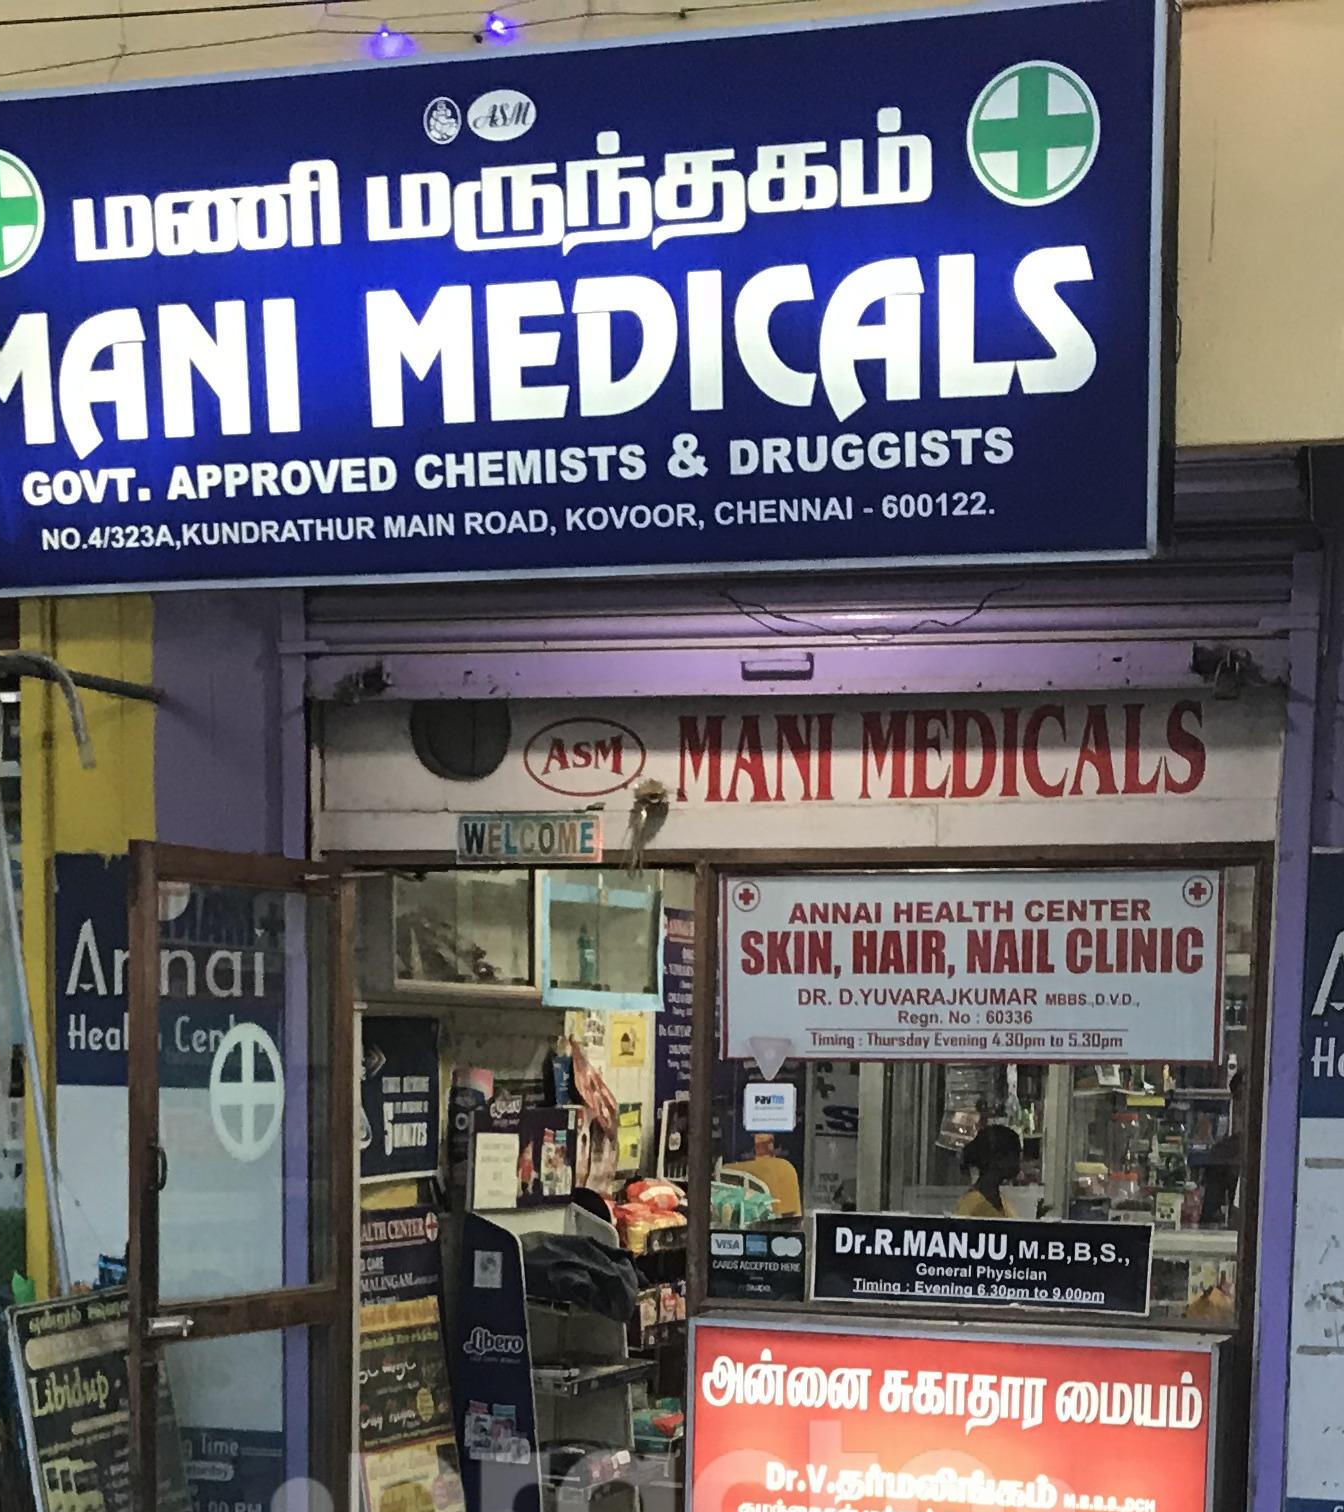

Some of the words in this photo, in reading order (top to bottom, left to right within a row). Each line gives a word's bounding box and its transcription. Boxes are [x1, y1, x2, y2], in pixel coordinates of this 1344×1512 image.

[73, 159, 340, 264] மணி
[367, 106, 934, 255] மருந்தகம்
[365, 245, 1099, 426] MEDICALS
[22, 467, 151, 508] GOVT.
[167, 456, 398, 502] APPROVED
[415, 444, 648, 489] CHEMISTS
[667, 432, 710, 479] &
[729, 426, 1015, 476] DRUGGISTS
[41, 517, 375, 552] NO.4/323A,KUNDRATHUR
[383, 513, 455, 539] MAIN
[464, 509, 558, 538] ROAD,
[565, 502, 706, 532] KOVOOR,
[714, 496, 853, 526] CHENNAI
[882, 490, 996, 519] 600122.
[541, 735, 625, 776] ASM
[676, 712, 836, 803] MANI
[859, 700, 1208, 800] MEDICALS
[463, 818, 596, 857] WELCOME
[788, 902, 882, 925] ANNAI
[893, 901, 1014, 924] HEALTH
[1024, 899, 1152, 922] CENTER
[740, 929, 842, 980] SKIN,
[851, 928, 957, 979] HAIR,
[966, 927, 1054, 974] NAIL
[1066, 926, 1204, 974] CLINIC
[797, 988, 834, 1007] DR.
[839, 987, 1037, 1007] D.YUVARAJKUMAR
[898, 1009, 944, 1026] Regn.
[948, 1009, 971, 1025] No
[985, 1008, 1034, 1026] 60336
[810, 1032, 856, 1050] Timing
[867, 1032, 931, 1050] Thursday
[934, 1032, 988, 1050] Evening
[992, 1032, 1046, 1050] 4.30pm
[1050, 1033, 1064, 1048] to
[1068, 1032, 1124, 1050] 5.30pm
[714, 1239, 741, 1251] VISA
[835, 1226, 1016, 1266] Dr.R.MANJU,
[739, 1261, 779, 1272] ACCEPTED
[780, 1262, 802, 1273] HERE
[915, 1262, 972, 1279] General
[976, 1265, 1048, 1282] Physician
[853, 1278, 901, 1294] Timing
[914, 1281, 973, 1298] Evening
[977, 1284, 1031, 1301] 6.30pm
[1033, 1286, 1049, 1300] to
[1052, 1287, 1105, 1304] 9.00pm
[463, 1326, 525, 1356] Libero
[702, 1348, 872, 1412] அன்னை
[878, 1369, 1048, 1436] சுகாதார
[1055, 1370, 1203, 1431] மையம்
